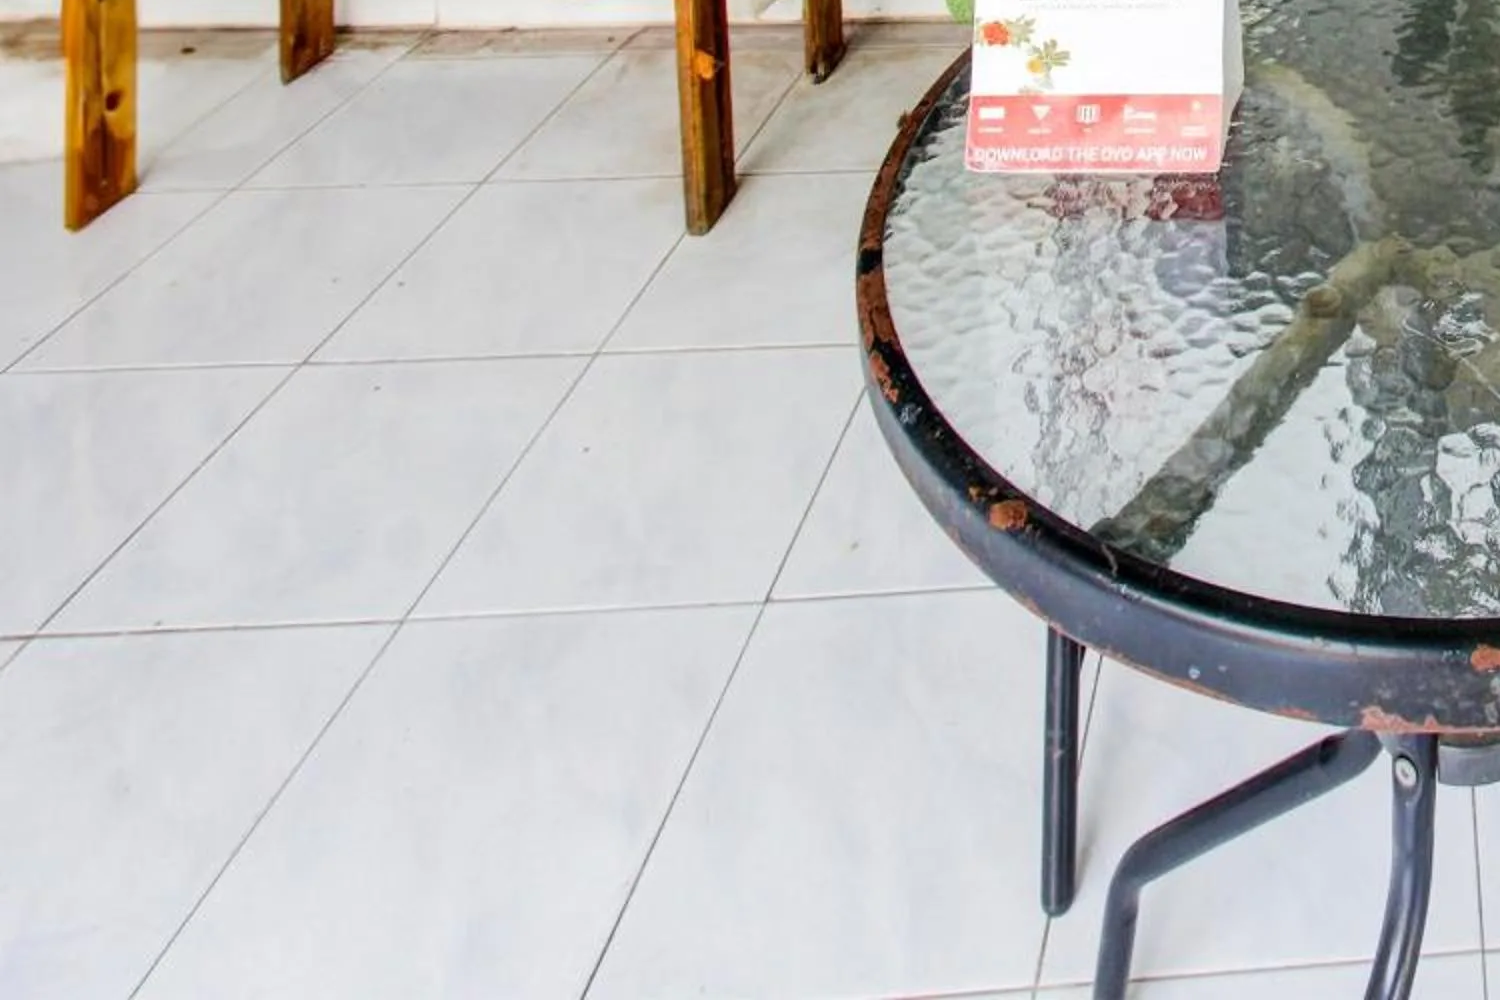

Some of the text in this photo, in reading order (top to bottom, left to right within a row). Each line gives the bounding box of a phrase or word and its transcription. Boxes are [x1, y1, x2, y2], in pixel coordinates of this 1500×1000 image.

[975, 147, 1063, 162] DOWNLOAD
[1069, 147, 1099, 161] THE
[1137, 147, 1167, 161] APP
[1170, 147, 1208, 161] NOW
